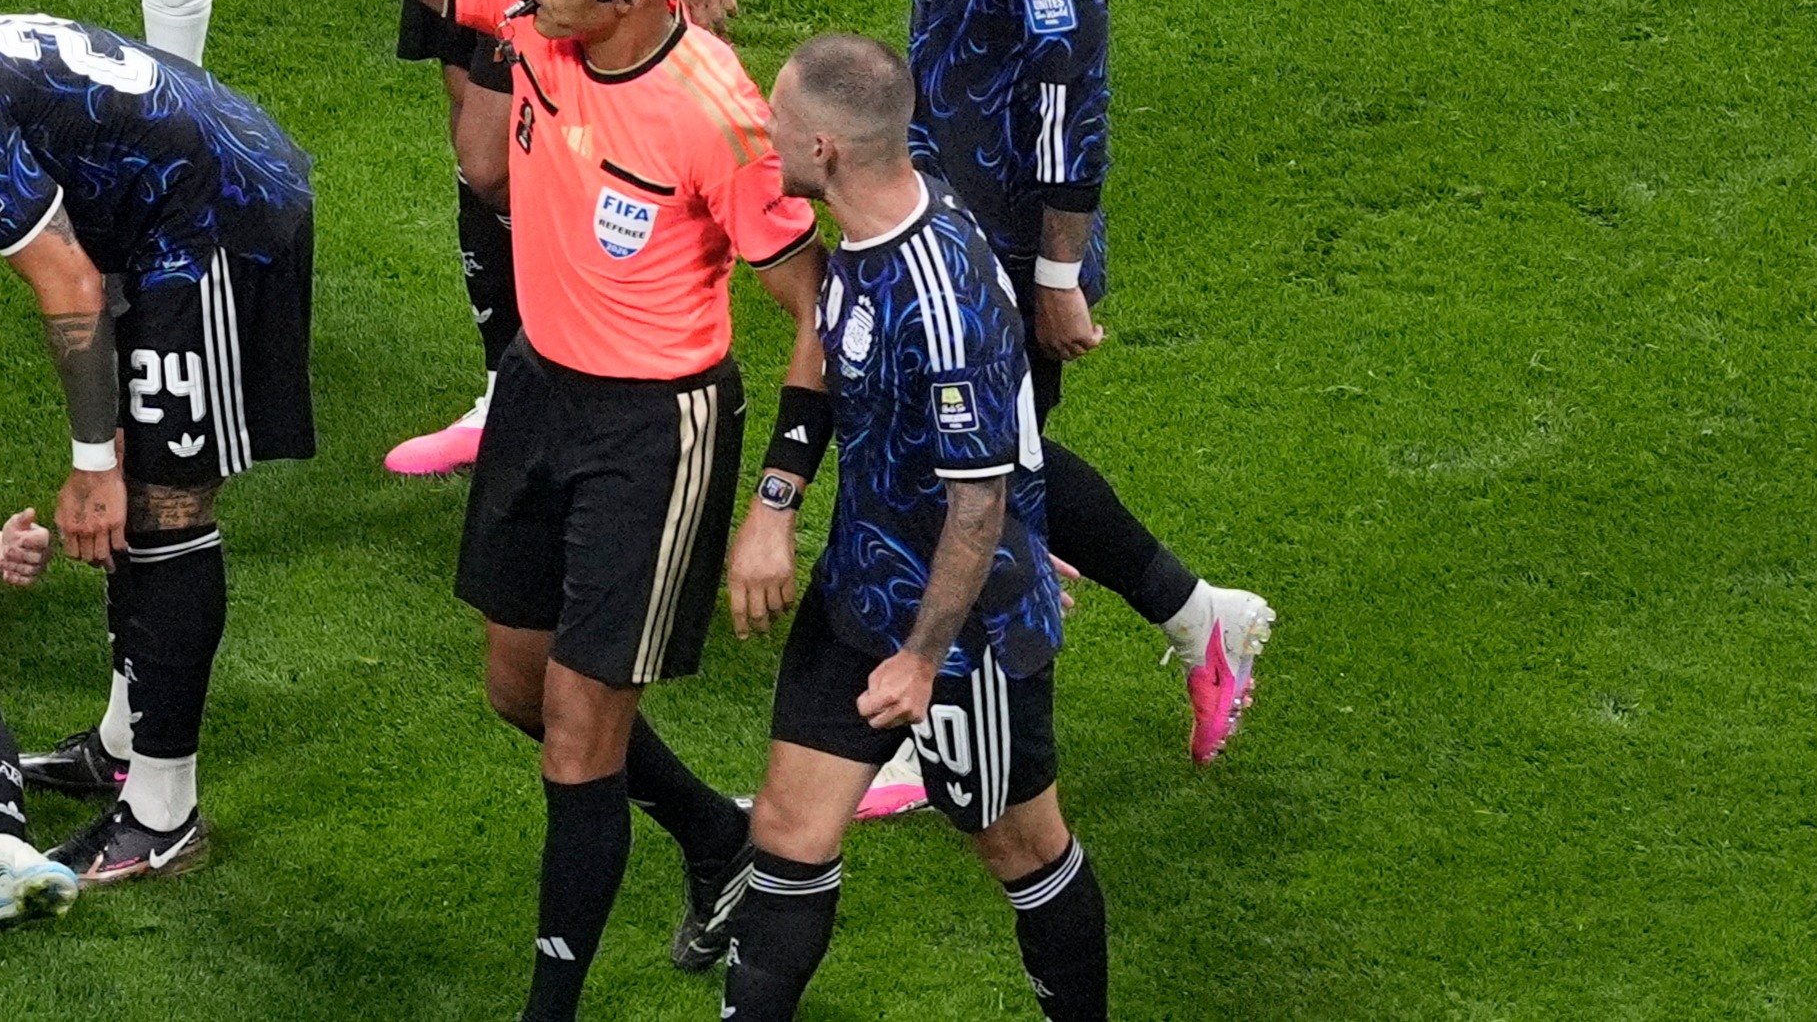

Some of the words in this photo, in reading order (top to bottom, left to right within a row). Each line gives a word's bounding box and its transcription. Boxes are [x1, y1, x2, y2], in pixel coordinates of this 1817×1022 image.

[598, 218, 646, 239] REFEREE
[603, 194, 650, 222] FIFA
[128, 348, 207, 425] 24
[910, 704, 972, 777] 20
